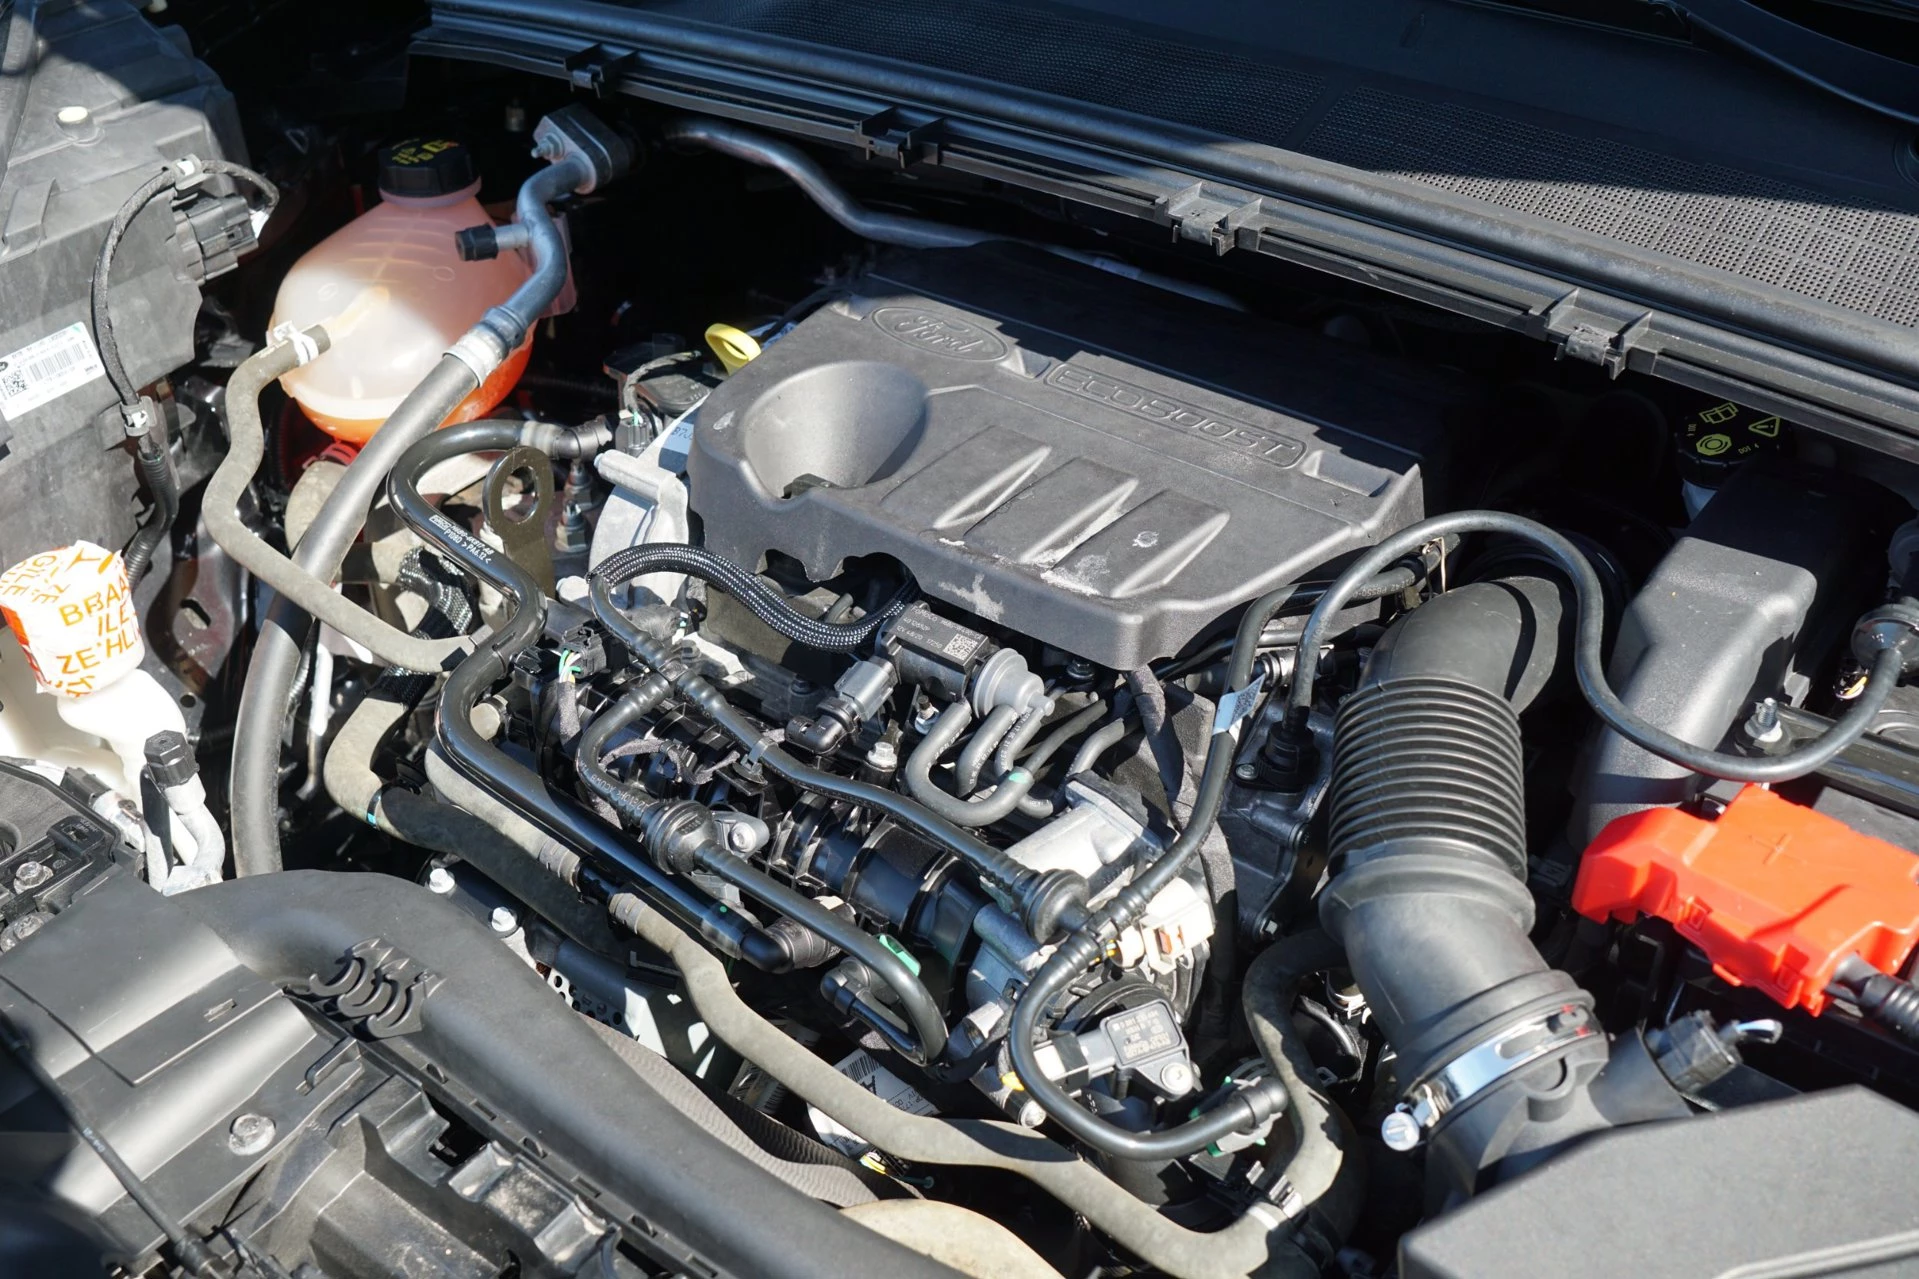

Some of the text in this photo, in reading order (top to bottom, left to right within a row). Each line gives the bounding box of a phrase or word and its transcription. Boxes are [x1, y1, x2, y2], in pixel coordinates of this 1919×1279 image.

[895, 316, 984, 353] Ford
[1055, 370, 1297, 456] ECOBOOST
[1738, 445, 1752, 454] DOT
